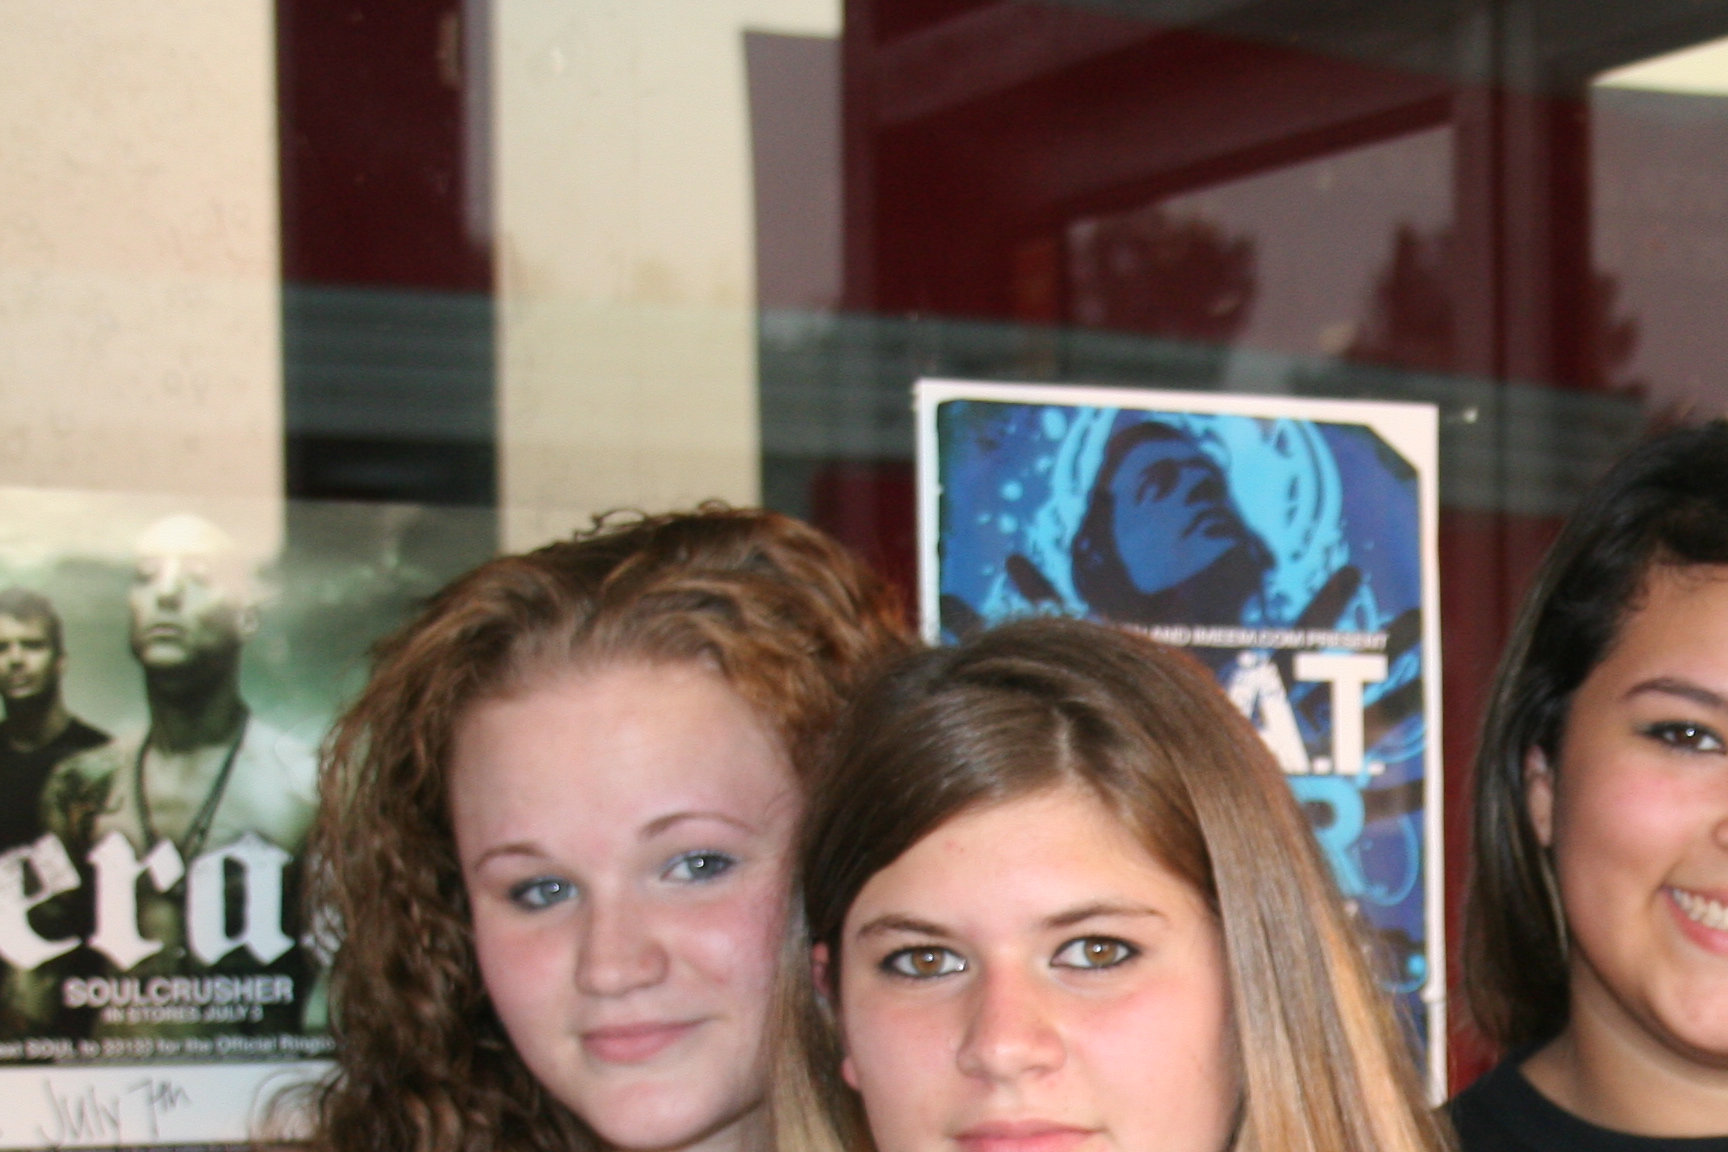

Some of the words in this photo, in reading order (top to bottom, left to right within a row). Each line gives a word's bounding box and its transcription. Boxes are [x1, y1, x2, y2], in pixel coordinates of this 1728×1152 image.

[0, 832, 297, 971] era
[64, 976, 294, 1008] SOULCRUSHER
[203, 1004, 248, 1022] JULY
